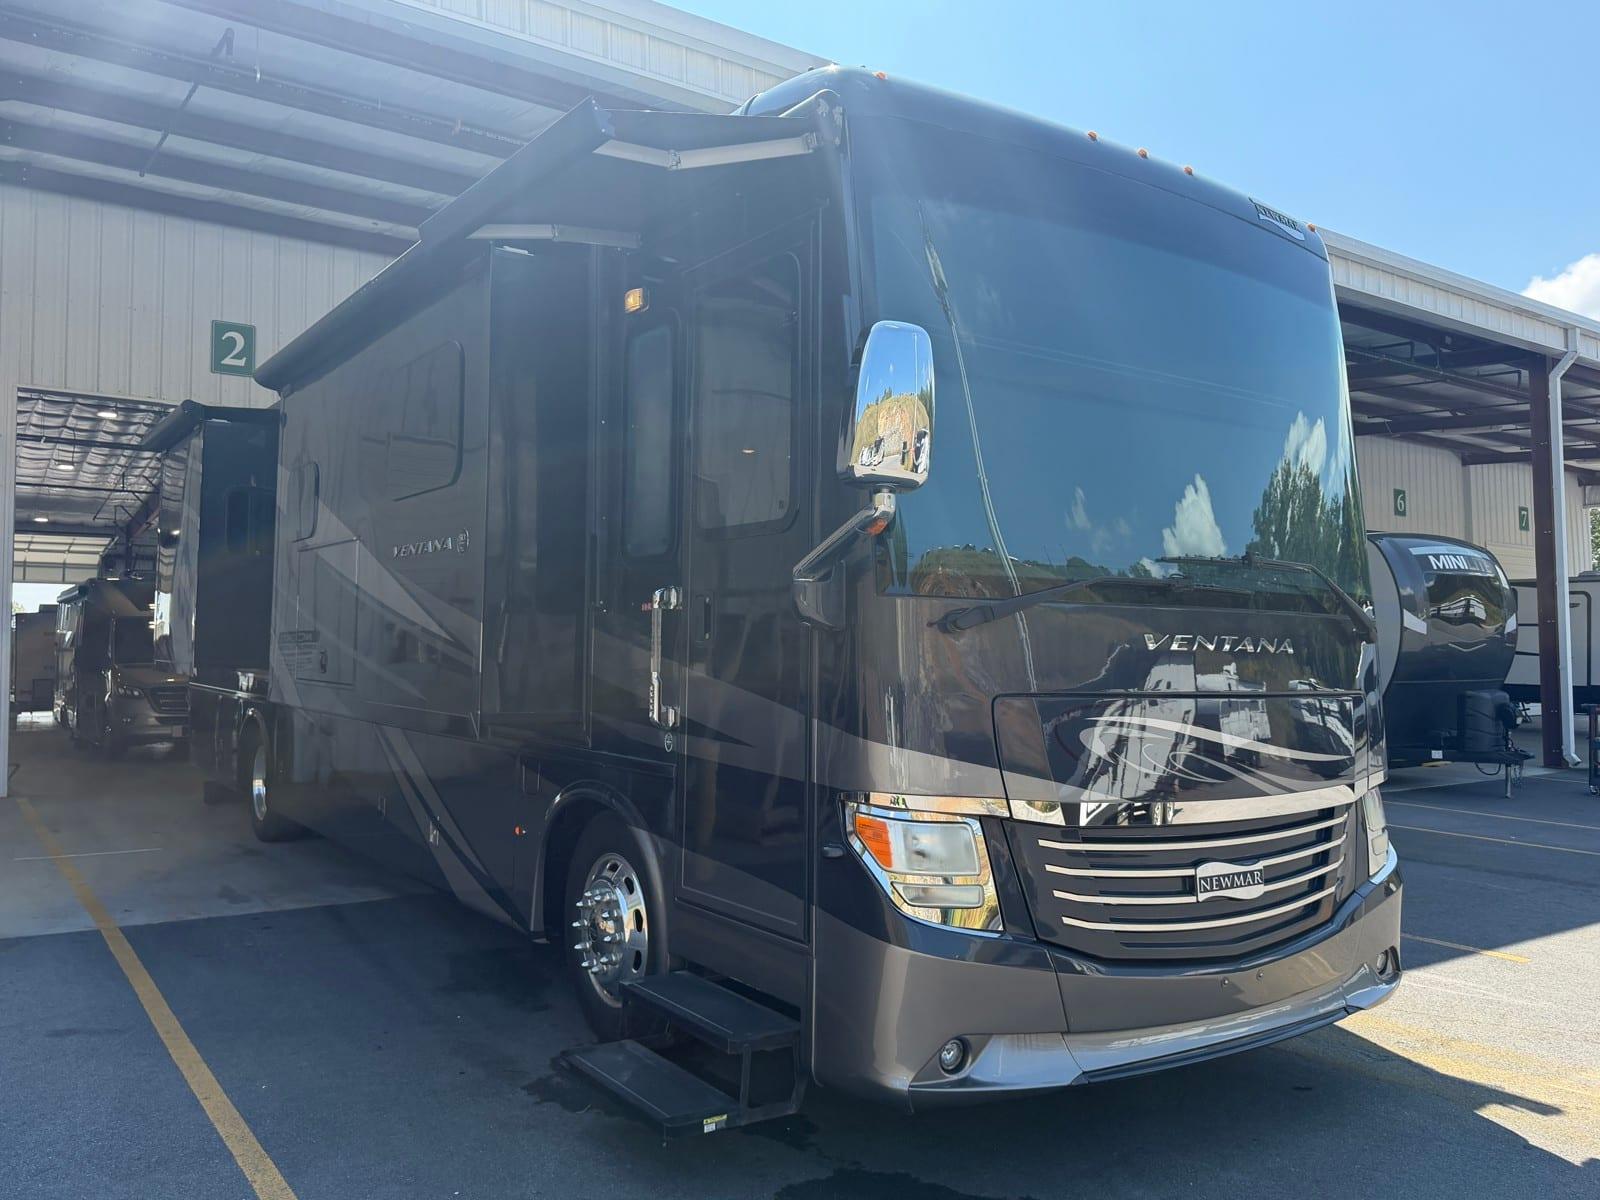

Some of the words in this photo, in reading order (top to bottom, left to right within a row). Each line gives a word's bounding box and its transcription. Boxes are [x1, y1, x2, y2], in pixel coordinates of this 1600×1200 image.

[220, 331, 247, 366] 2
[1396, 493, 1405, 512] 6
[1520, 510, 1528, 527] 7
[392, 536, 453, 557] VENTANA
[1143, 633, 1295, 655] VENTANA
[1199, 871, 1264, 893] NEWMAR
